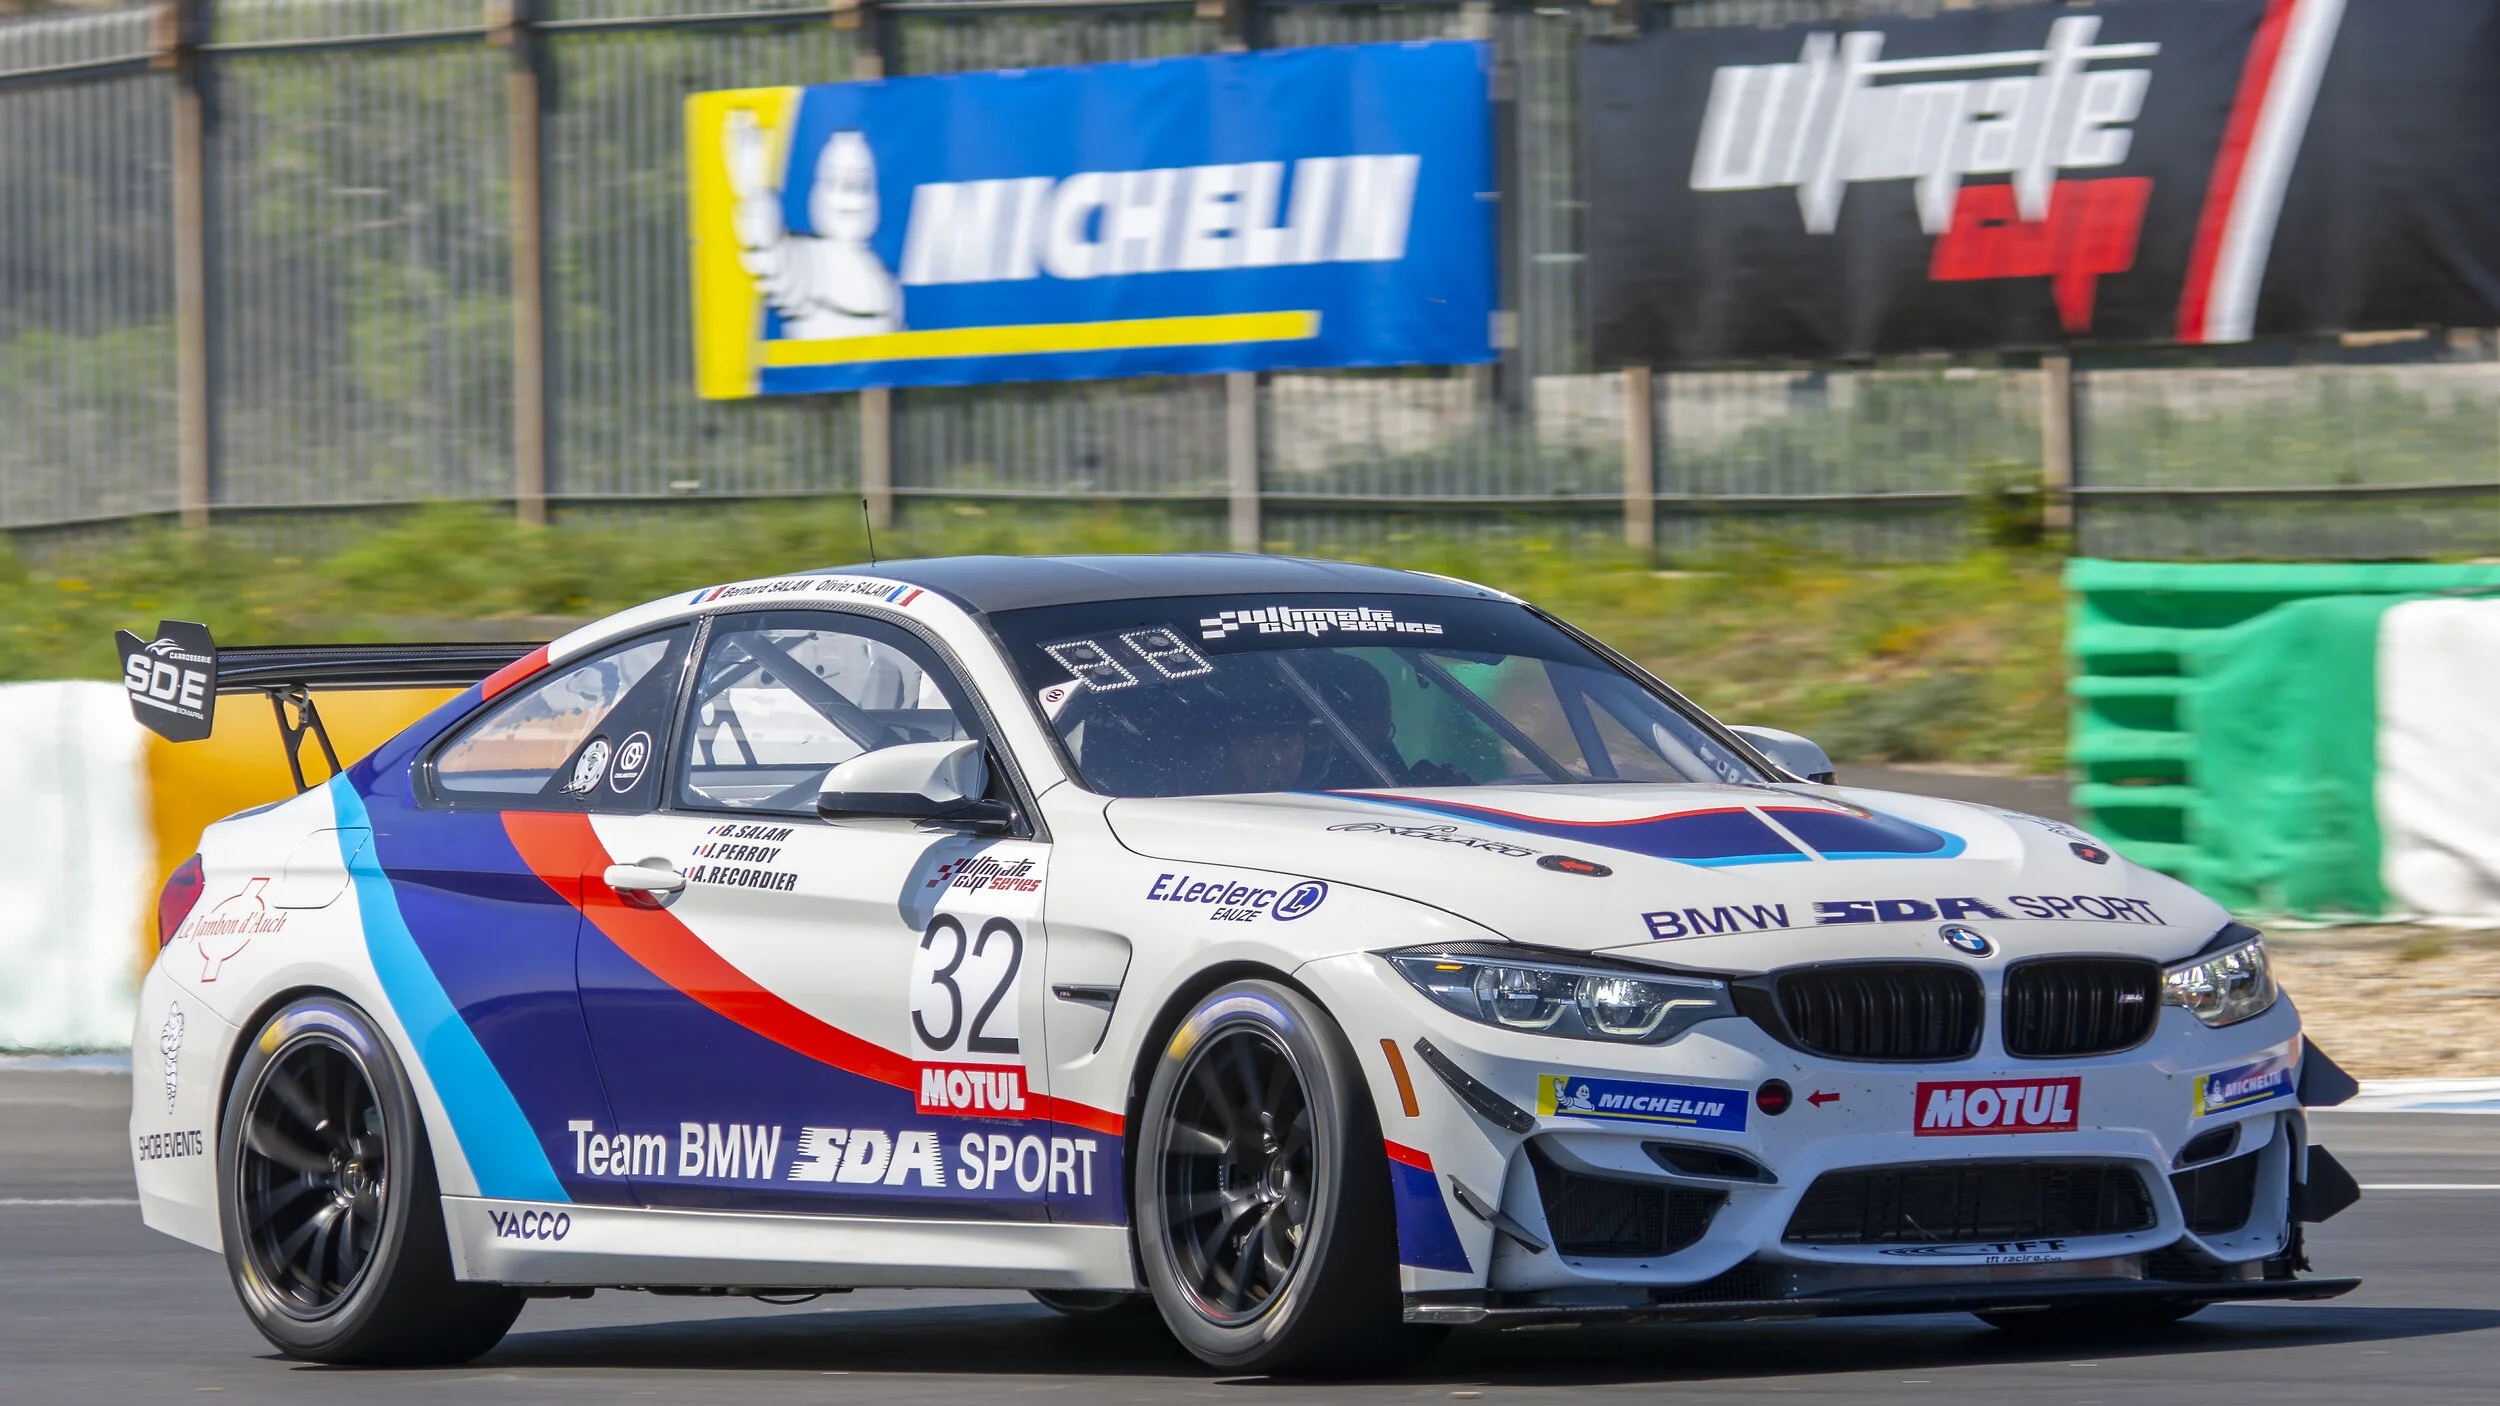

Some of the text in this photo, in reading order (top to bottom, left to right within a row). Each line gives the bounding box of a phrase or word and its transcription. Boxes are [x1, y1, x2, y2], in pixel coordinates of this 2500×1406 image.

[901, 153, 1421, 286] MICHELIN
[721, 579, 895, 599] Bernard SALAM Olivier SALAM
[169, 652, 212, 664] CARROSSERIE
[124, 653, 208, 709] SDE
[719, 824, 794, 842] B.SALAM
[704, 843, 781, 863] J.PERROY
[692, 865, 798, 891] A.RECORDIER
[1146, 873, 1277, 908] E.Leclerc
[178, 911, 287, 943] Le Jambon d'Auch
[1210, 907, 1262, 922] EAUZE
[1641, 895, 2168, 940] BMW SDA SPORT
[911, 912, 1024, 1054] 32
[921, 1068, 1026, 1111] MOTUL
[2224, 1071, 2282, 1097] MICHELIN
[1598, 1093, 1725, 1117] MICHELIN
[1921, 1084, 2073, 1127] MOTUL
[139, 1130, 203, 1161] SHOB EVENTS
[567, 1120, 1097, 1195] Team BMW SDA SPORT
[488, 1209, 571, 1241] YACCO
[1987, 1240, 2066, 1252] TFT
